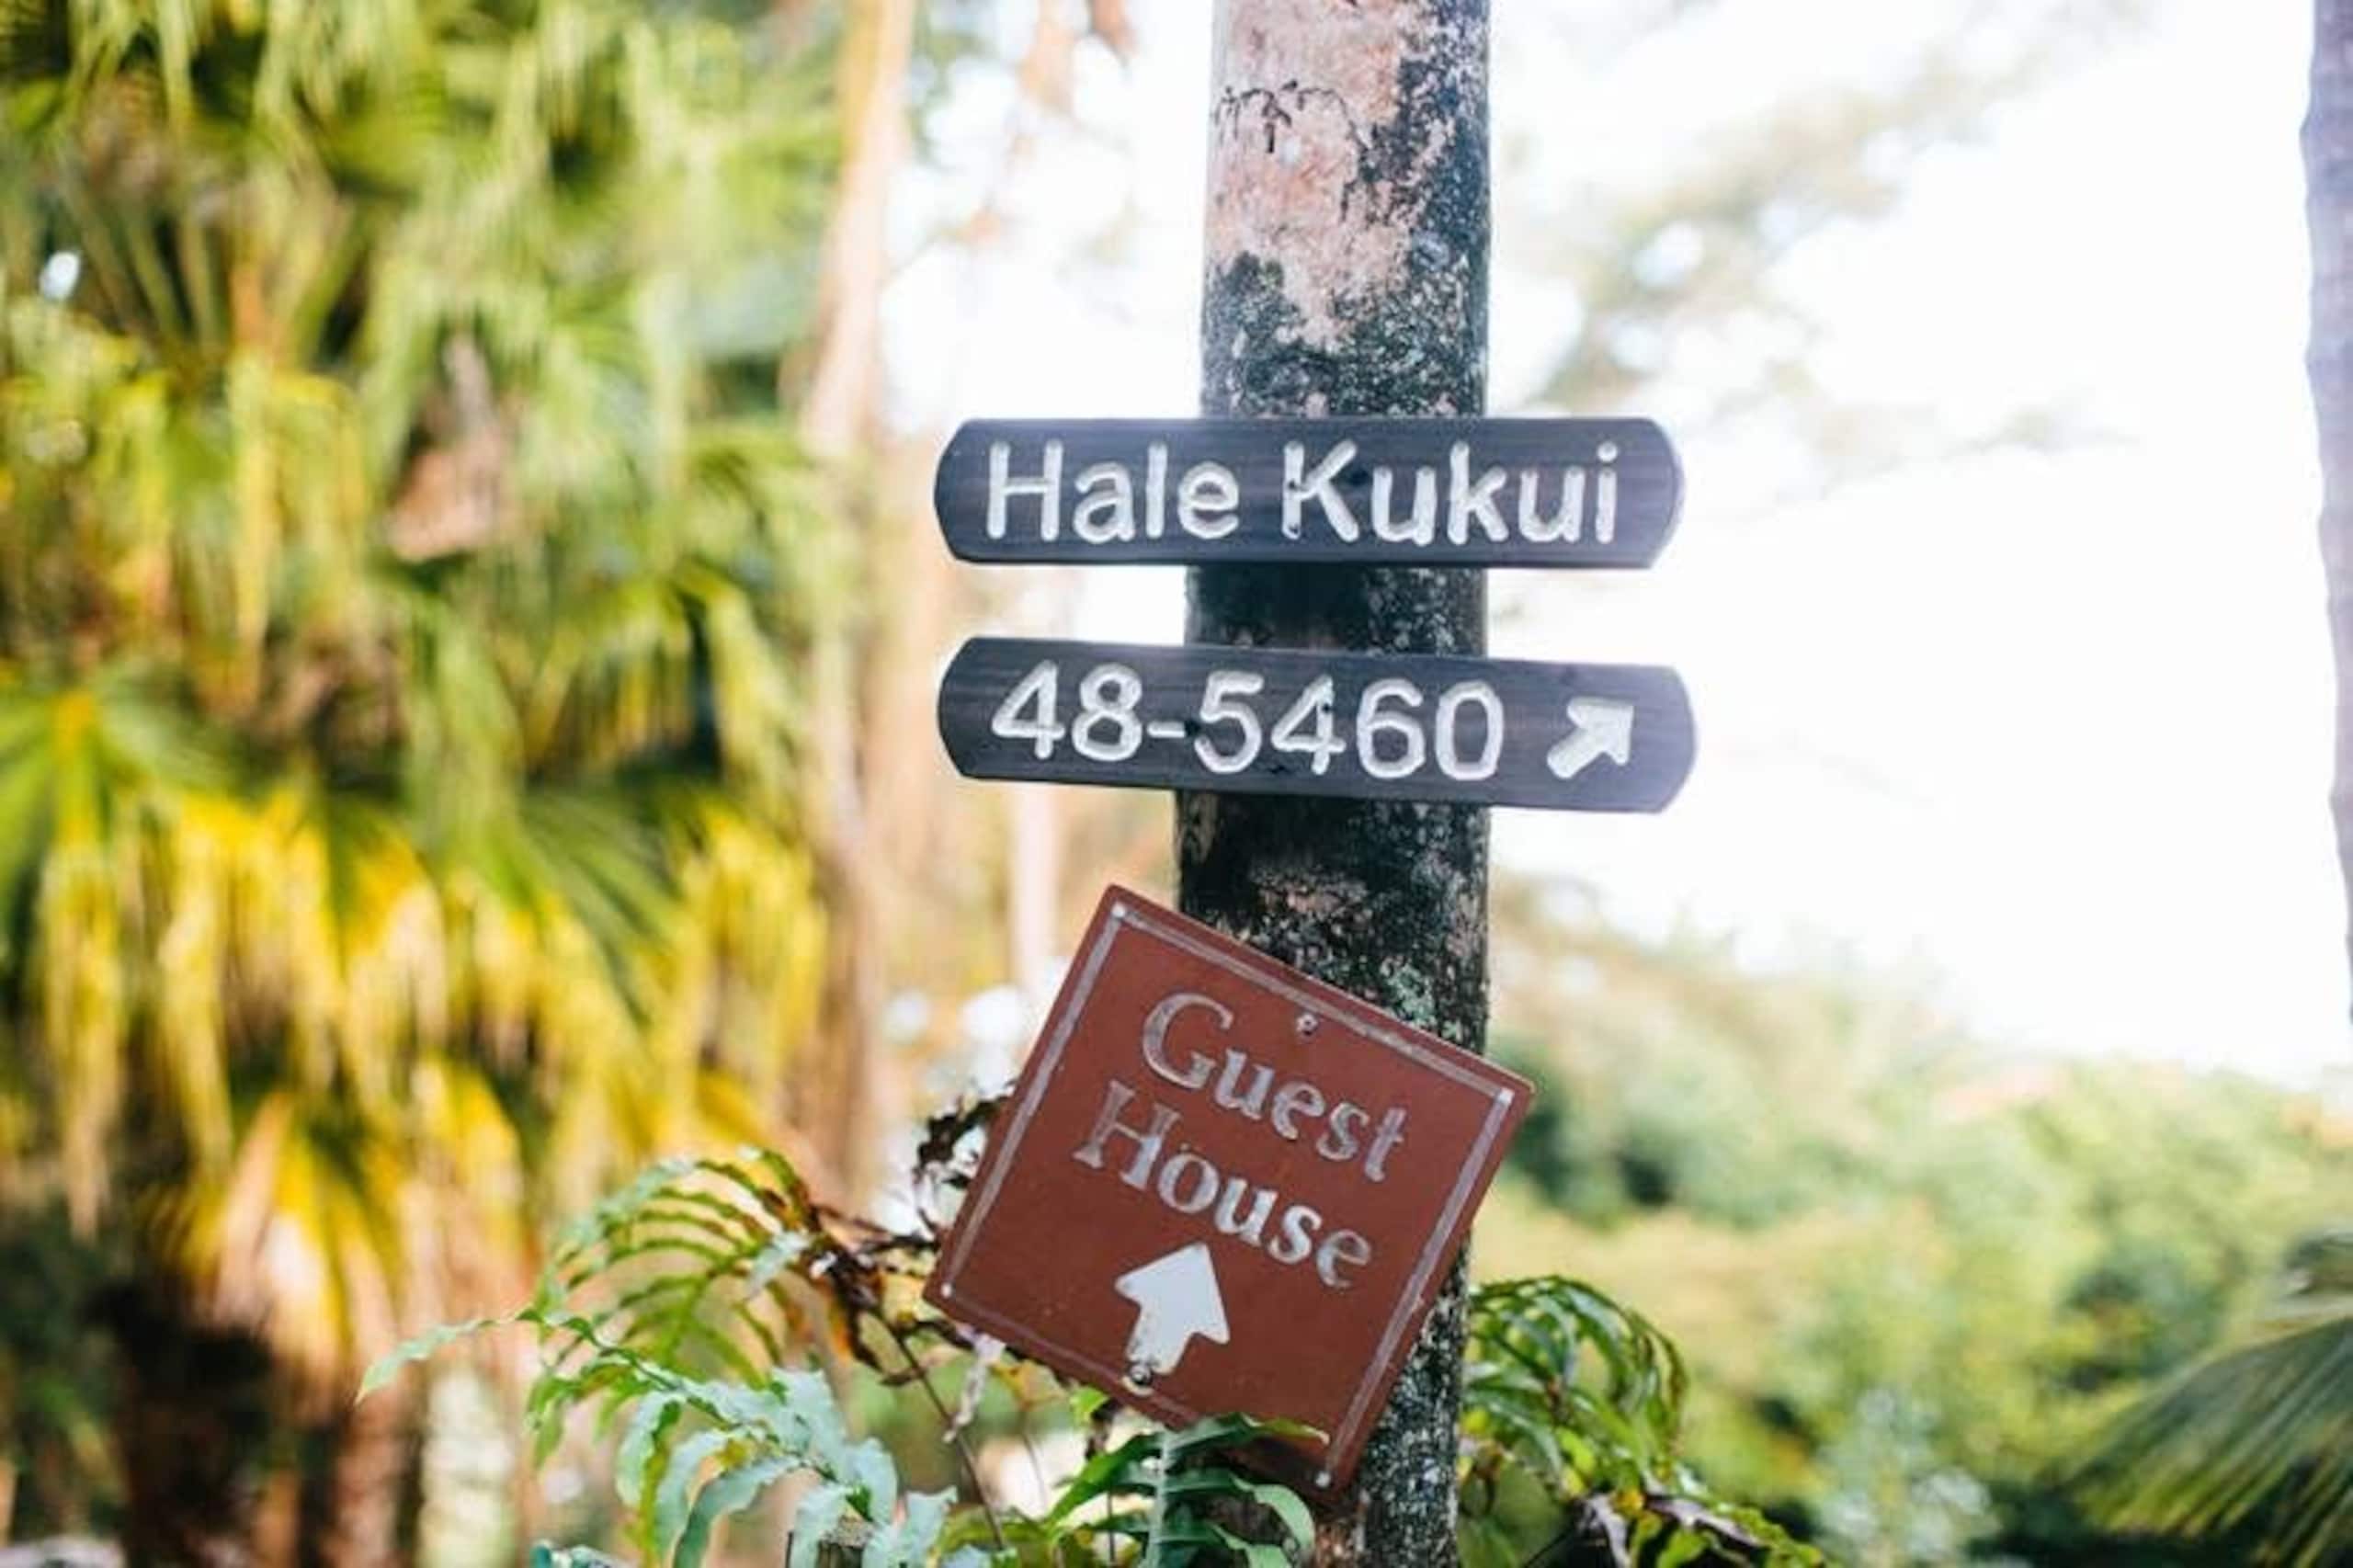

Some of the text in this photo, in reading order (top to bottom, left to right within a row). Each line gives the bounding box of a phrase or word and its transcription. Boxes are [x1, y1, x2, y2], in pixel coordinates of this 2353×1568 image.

[985, 438, 1620, 547] Hale Kukui
[990, 660, 1506, 781] 48-5460
[1140, 991, 1407, 1183] Guest
[1072, 1079, 1372, 1289] House
